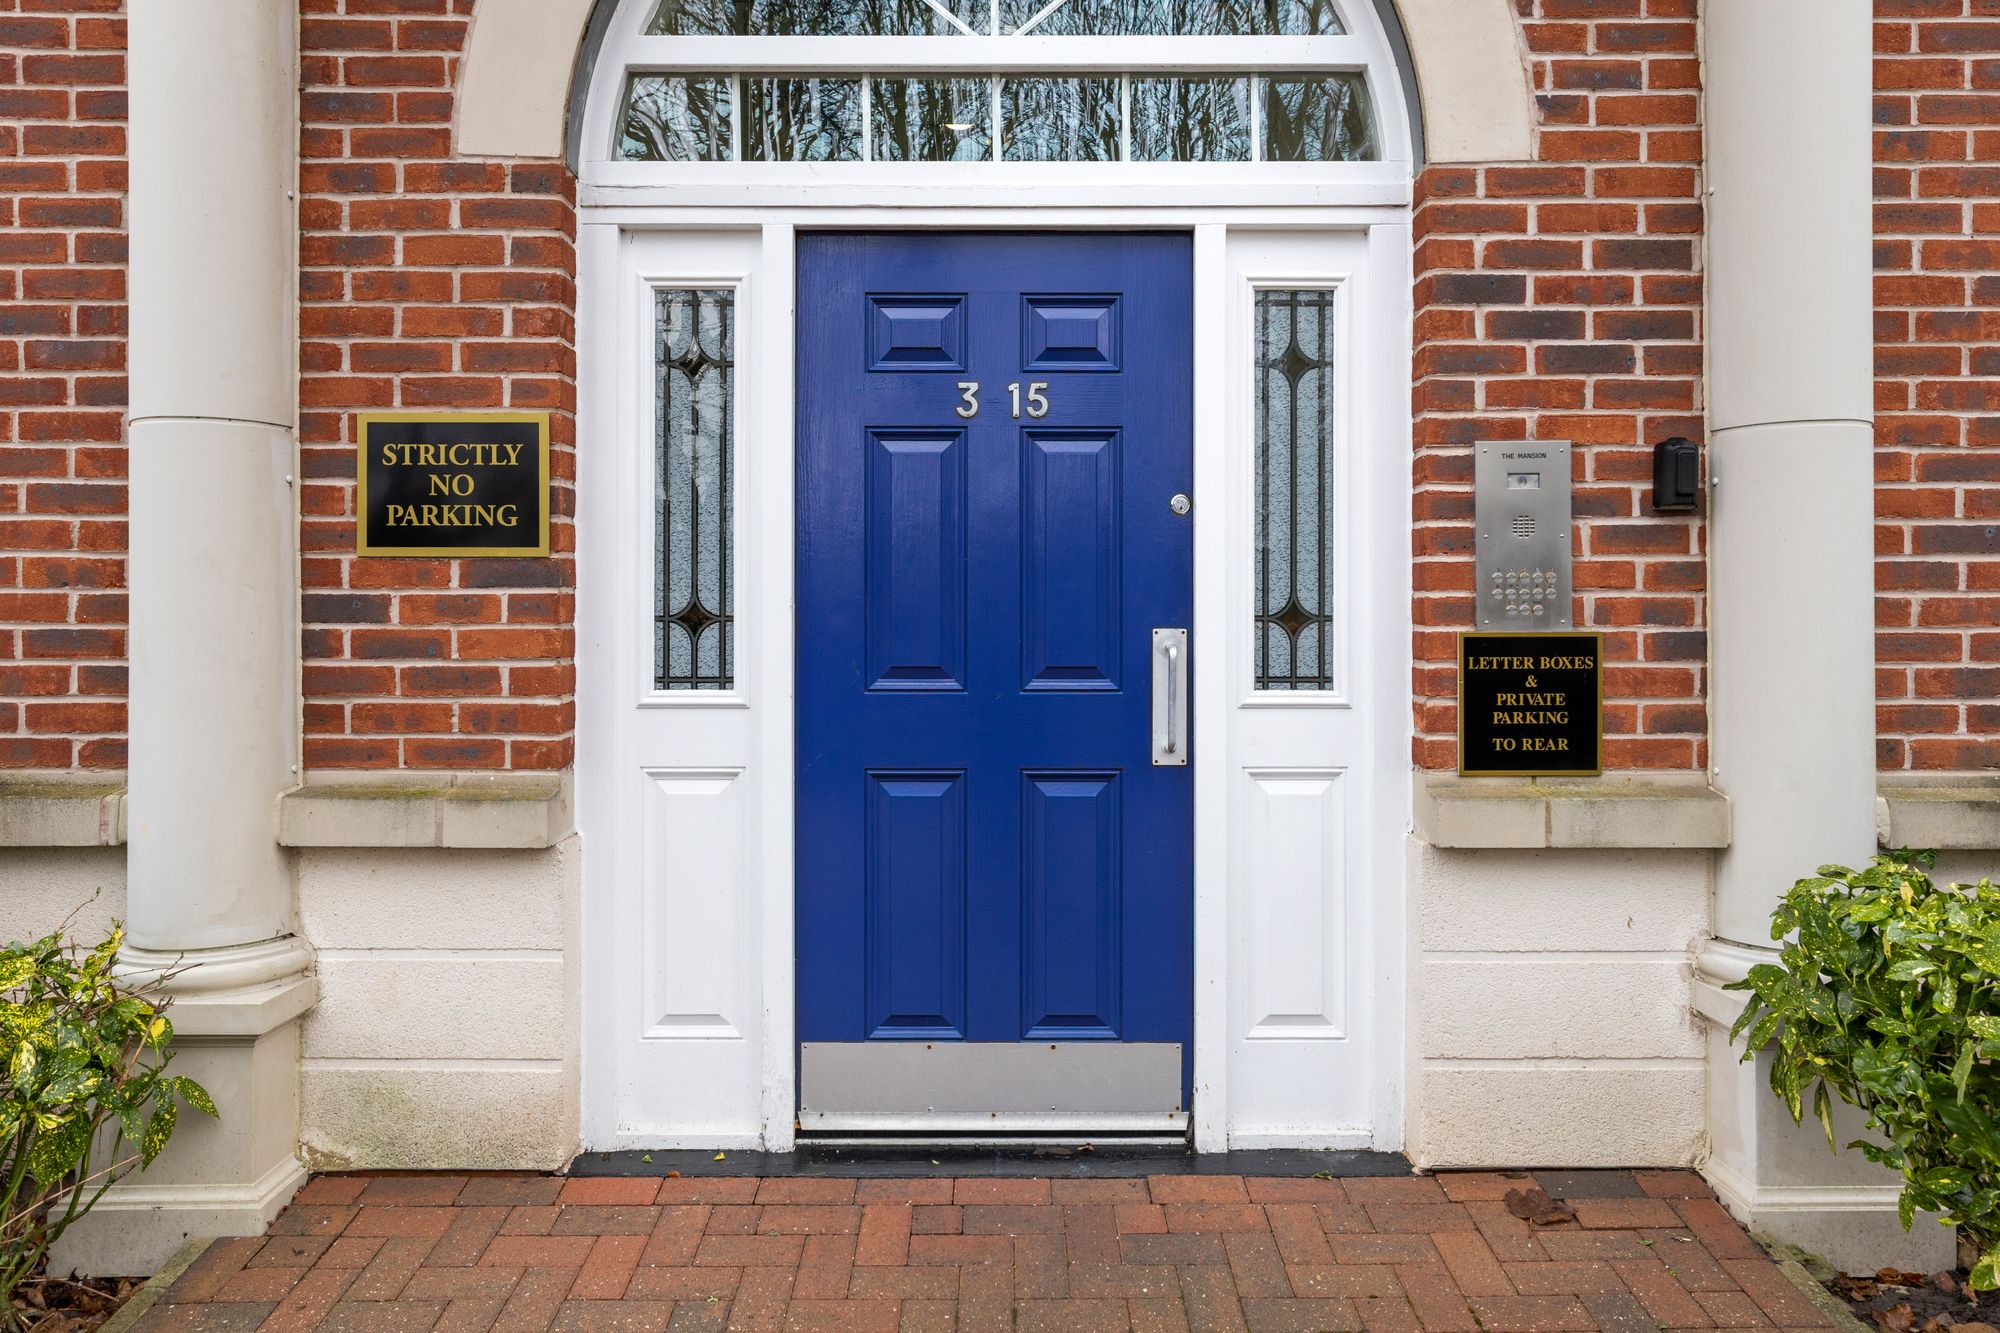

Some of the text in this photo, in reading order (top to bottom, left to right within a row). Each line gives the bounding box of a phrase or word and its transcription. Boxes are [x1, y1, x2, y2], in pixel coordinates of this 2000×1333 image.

[956, 382, 1049, 418] 3 15
[382, 443, 524, 466] STRICTLY
[1501, 452, 1547, 460] THE MANSION
[428, 473, 475, 497] NO
[386, 504, 519, 527] PARKING
[1468, 656, 1594, 670] LETTER BOXES
[1525, 675, 1538, 688] &
[1496, 693, 1566, 706] PRIVATE
[1492, 711, 1569, 725] PARKING
[1492, 738, 1569, 751] TO REAR
